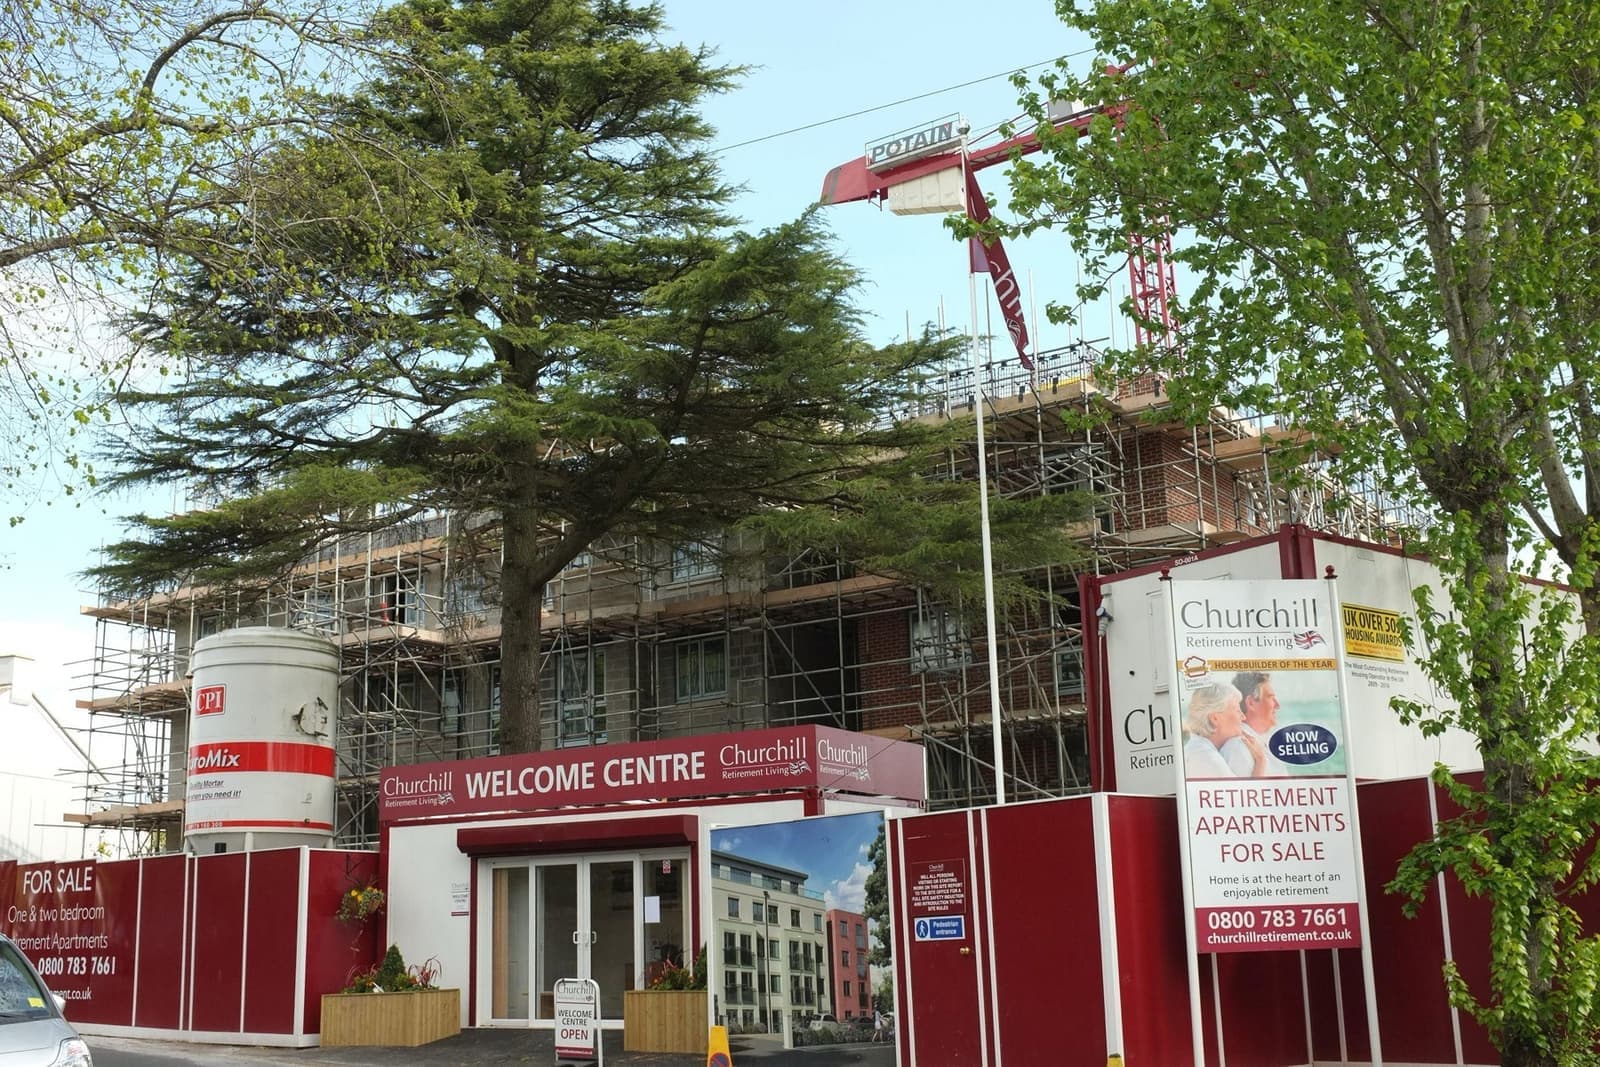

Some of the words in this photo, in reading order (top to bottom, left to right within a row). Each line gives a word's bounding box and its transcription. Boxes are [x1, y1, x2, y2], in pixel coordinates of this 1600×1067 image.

[872, 122, 952, 163] POTAIN
[1181, 598, 1318, 628] Churchill
[1344, 610, 1358, 628] UK
[1359, 612, 1384, 632] OVER
[1186, 635, 1252, 648] Retirement
[1256, 635, 1293, 650] Living
[1345, 628, 1374, 642] HOUSING
[1376, 632, 1402, 647] AWARDS
[1214, 660, 1278, 670] HOUSEBUILDER
[1280, 660, 1292, 669] OF
[1294, 659, 1309, 668] THE
[1310, 659, 1333, 668] YEAR
[196, 690, 222, 711] CPI
[1285, 731, 1318, 743] NOW
[720, 737, 806, 767] Churchill
[818, 739, 868, 766] Churchill
[1278, 742, 1329, 756] SELLING
[466, 762, 594, 800] WELCOME
[603, 751, 705, 788] CENTRE
[722, 768, 762, 779] Retirement
[765, 766, 790, 777] Living
[384, 772, 452, 796] Churchill
[385, 798, 416, 808] Retirement
[418, 797, 438, 806] Living
[1198, 787, 1338, 808] RETIREMENT
[1196, 813, 1346, 836] APARTMENTS
[1221, 842, 1264, 863] FOR
[1272, 842, 1325, 862] SALE
[23, 870, 52, 894] FOR
[57, 866, 93, 893] SALE
[1210, 875, 1239, 885] Home
[1242, 874, 1249, 884] is
[1252, 875, 1263, 884] at
[1266, 874, 1282, 883] the
[1285, 873, 1311, 883] heart
[1314, 872, 1326, 882] of
[1224, 887, 1272, 900] enjoyable
[1275, 886, 1329, 896] retirement
[8, 905, 27, 923] One
[29, 905, 37, 922] &
[40, 907, 58, 921] two
[60, 902, 104, 921] bedroom
[1208, 910, 1255, 929] 0800
[1261, 909, 1296, 928] 783
[1301, 908, 1346, 926] 7661
[51, 932, 108, 954] Apartments
[1208, 929, 1352, 944] churchillretirement.co.uk
[38, 957, 63, 975] 0800
[67, 957, 87, 975] 783
[91, 956, 116, 975] 7661
[558, 1010, 592, 1018] WELCOME
[561, 1029, 588, 1040] OPEN
